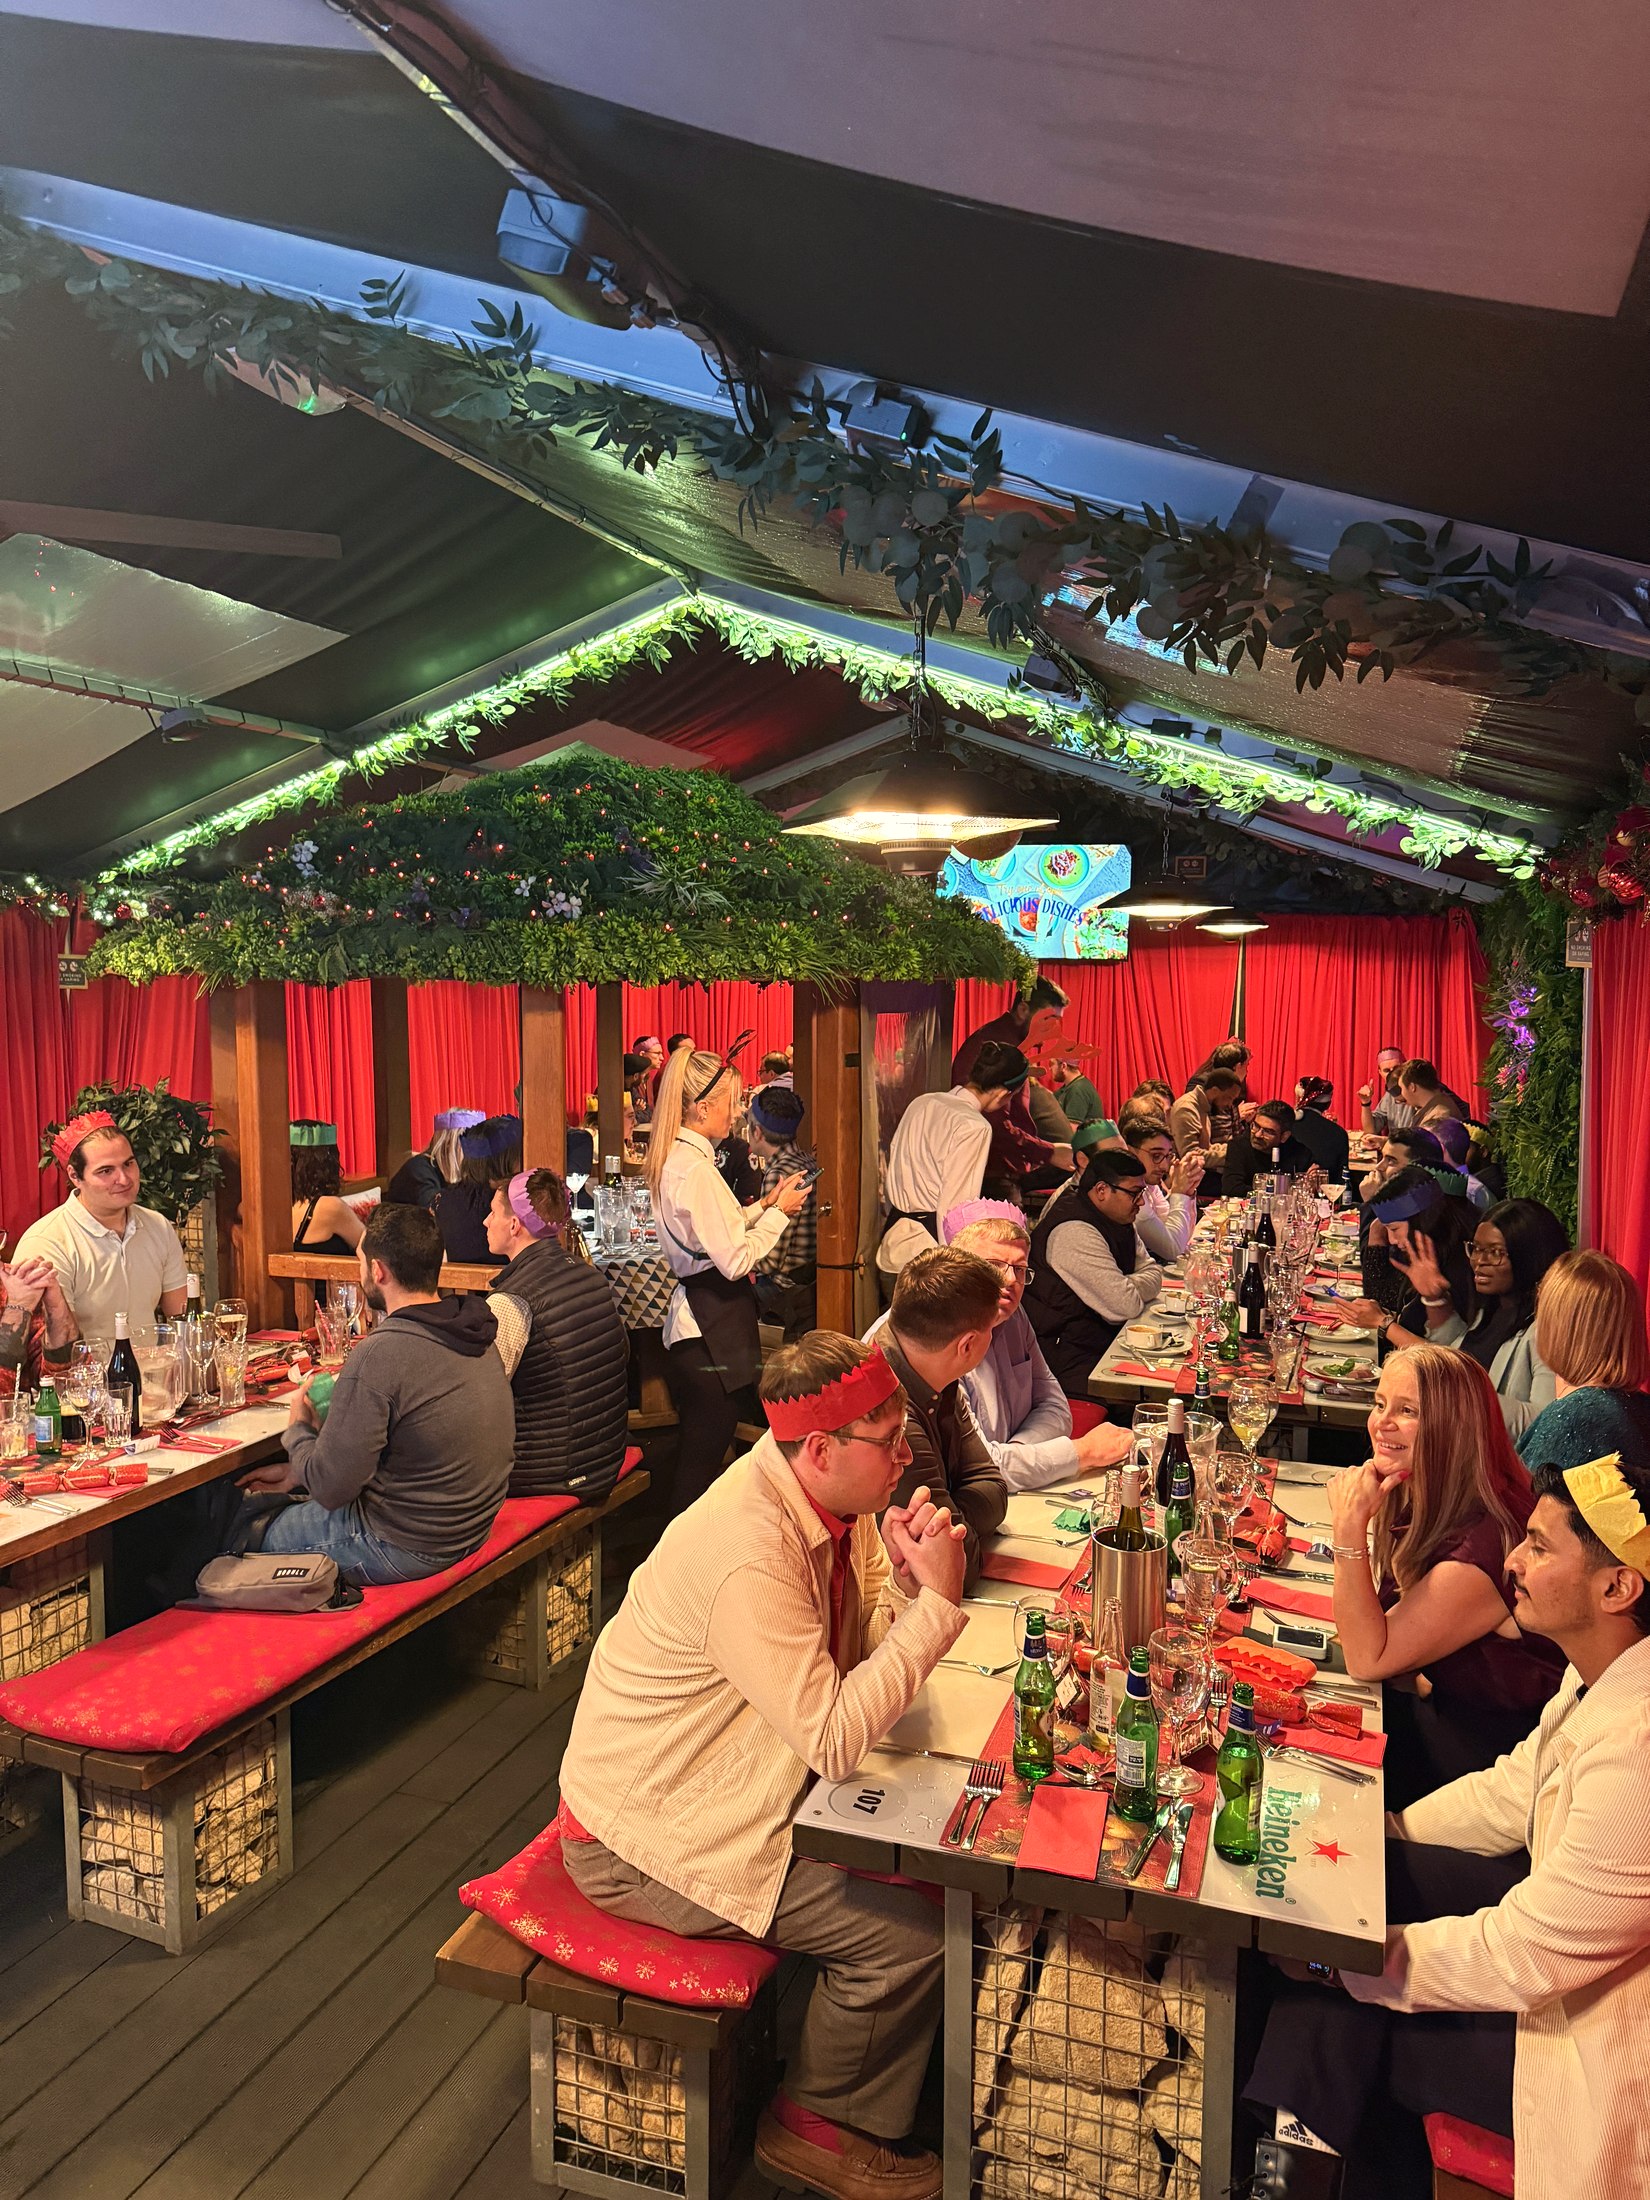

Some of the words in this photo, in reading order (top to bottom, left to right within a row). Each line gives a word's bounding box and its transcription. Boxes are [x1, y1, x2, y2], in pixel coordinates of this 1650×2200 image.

[1042, 899, 1084, 926] DISHES
[853, 1789, 885, 1815] 107
[1279, 2128, 1314, 2146] adidas
